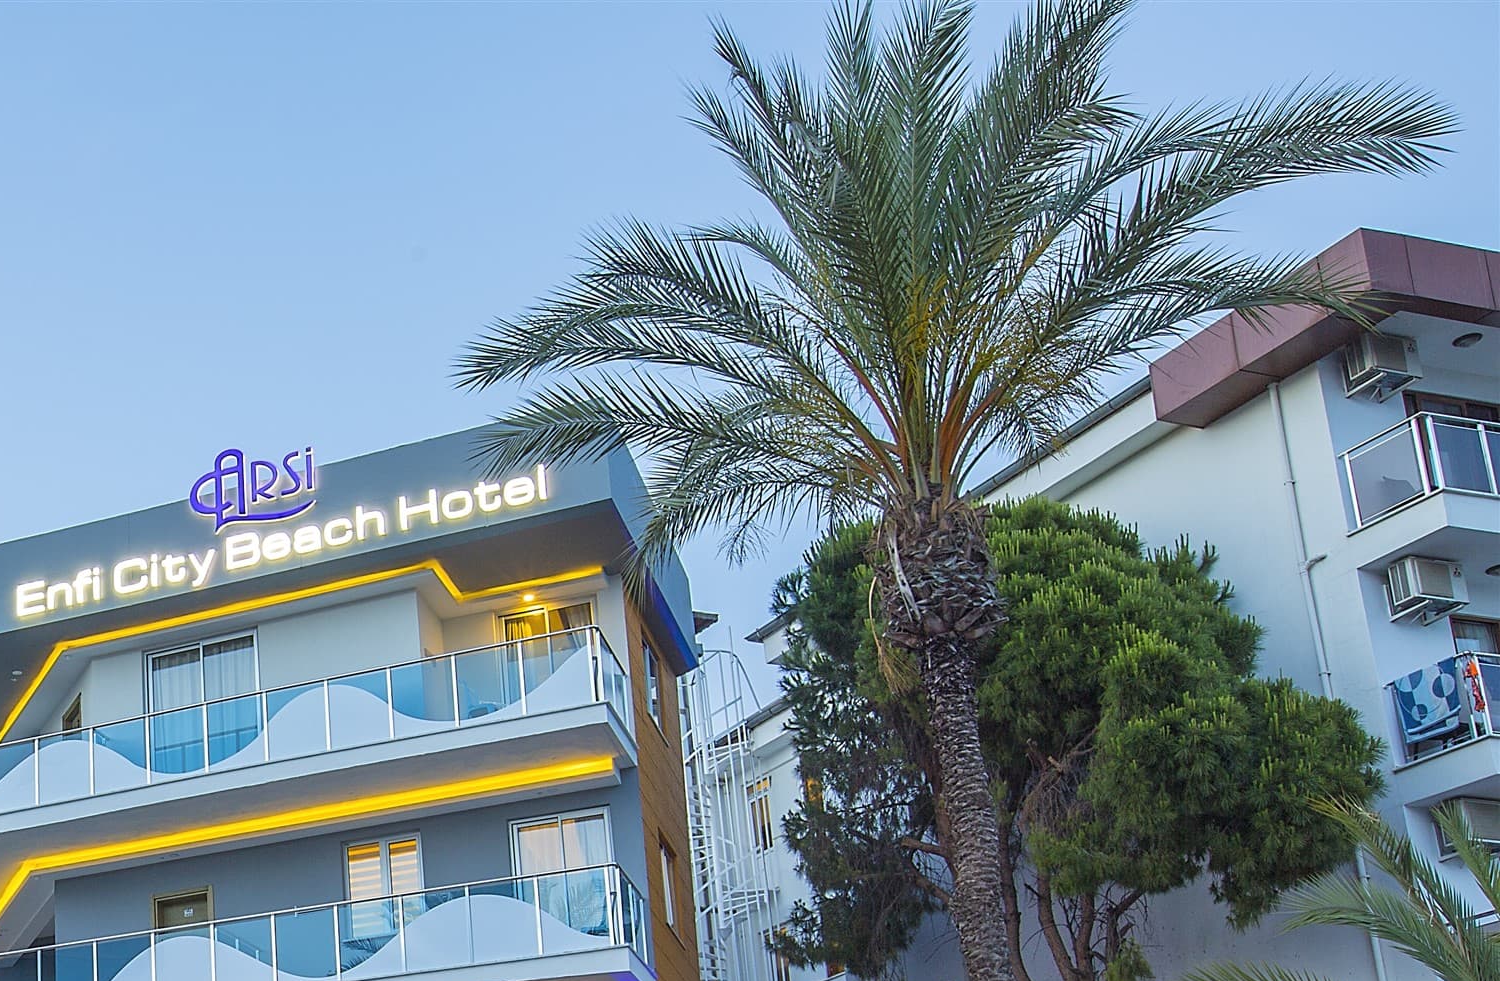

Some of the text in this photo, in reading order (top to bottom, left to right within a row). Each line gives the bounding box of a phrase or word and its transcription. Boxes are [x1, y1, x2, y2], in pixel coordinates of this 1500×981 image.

[15, 463, 549, 618] Enfi City Beach Hotel
